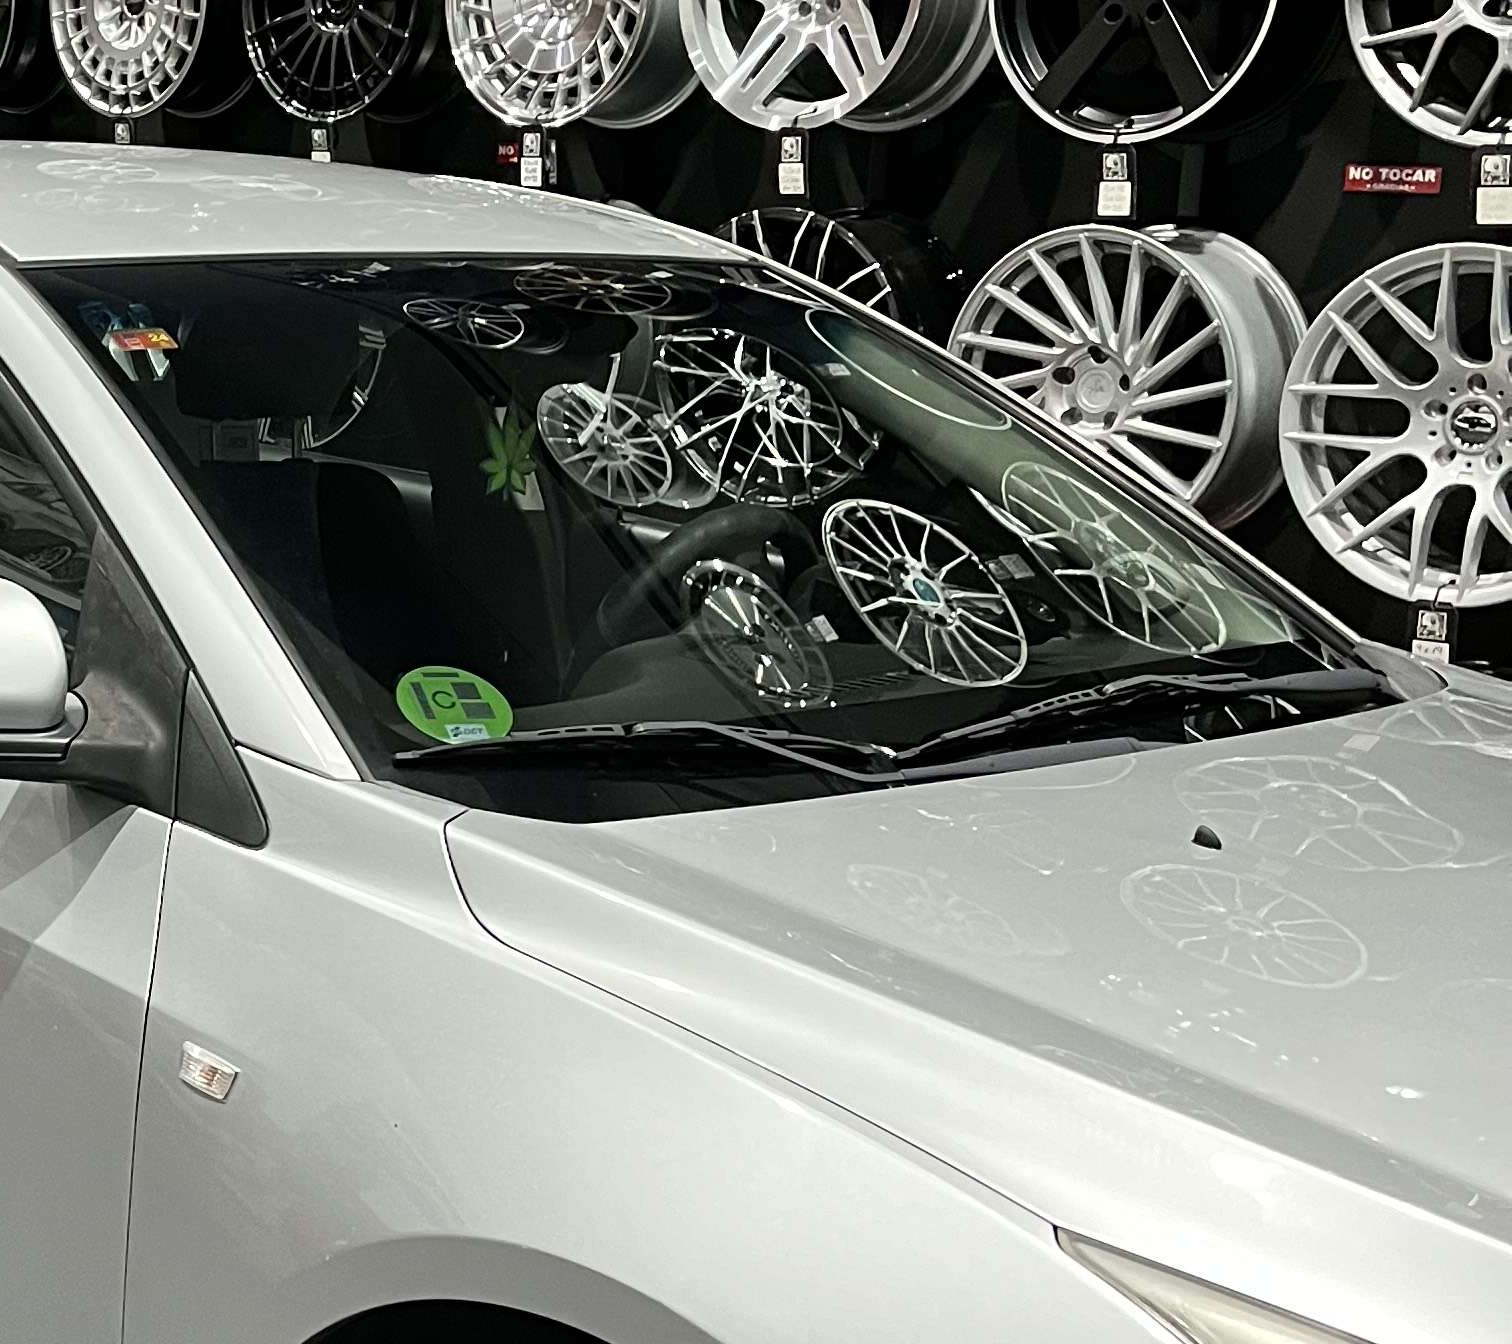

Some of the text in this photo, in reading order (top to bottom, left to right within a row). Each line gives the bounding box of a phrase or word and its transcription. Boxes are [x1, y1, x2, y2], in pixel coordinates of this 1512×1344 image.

[1348, 166, 1436, 183] NO TOCAR
[431, 690, 457, 710] C
